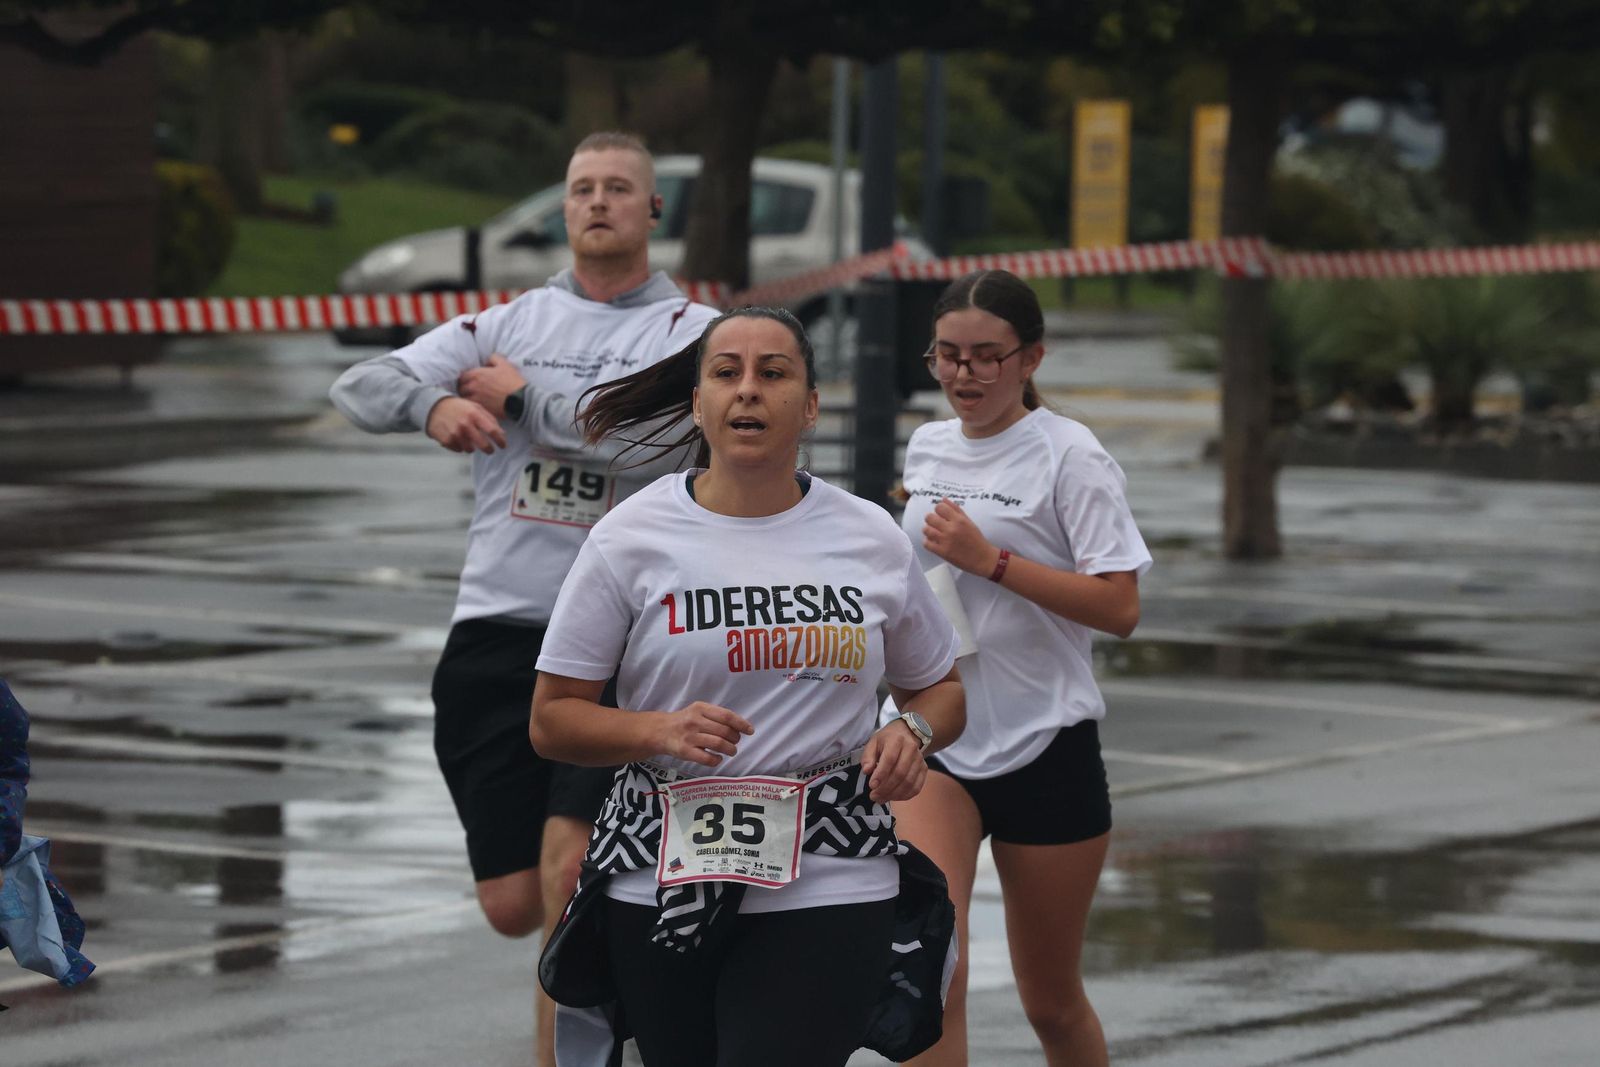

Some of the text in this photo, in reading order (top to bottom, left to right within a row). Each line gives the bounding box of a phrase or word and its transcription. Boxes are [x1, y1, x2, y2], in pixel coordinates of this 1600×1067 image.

[524, 462, 605, 501] 149
[992, 493, 1022, 506] Mujer
[726, 625, 867, 673] amazonas
[680, 786, 707, 797] CARRERA
[709, 784, 761, 792] MCARTHURGLEN
[692, 791, 740, 802] INTERNACIONAL
[761, 793, 783, 801] MUJER
[692, 803, 766, 845] 35
[696, 847, 719, 856] CABELLO
[743, 848, 760, 858] SONIA
